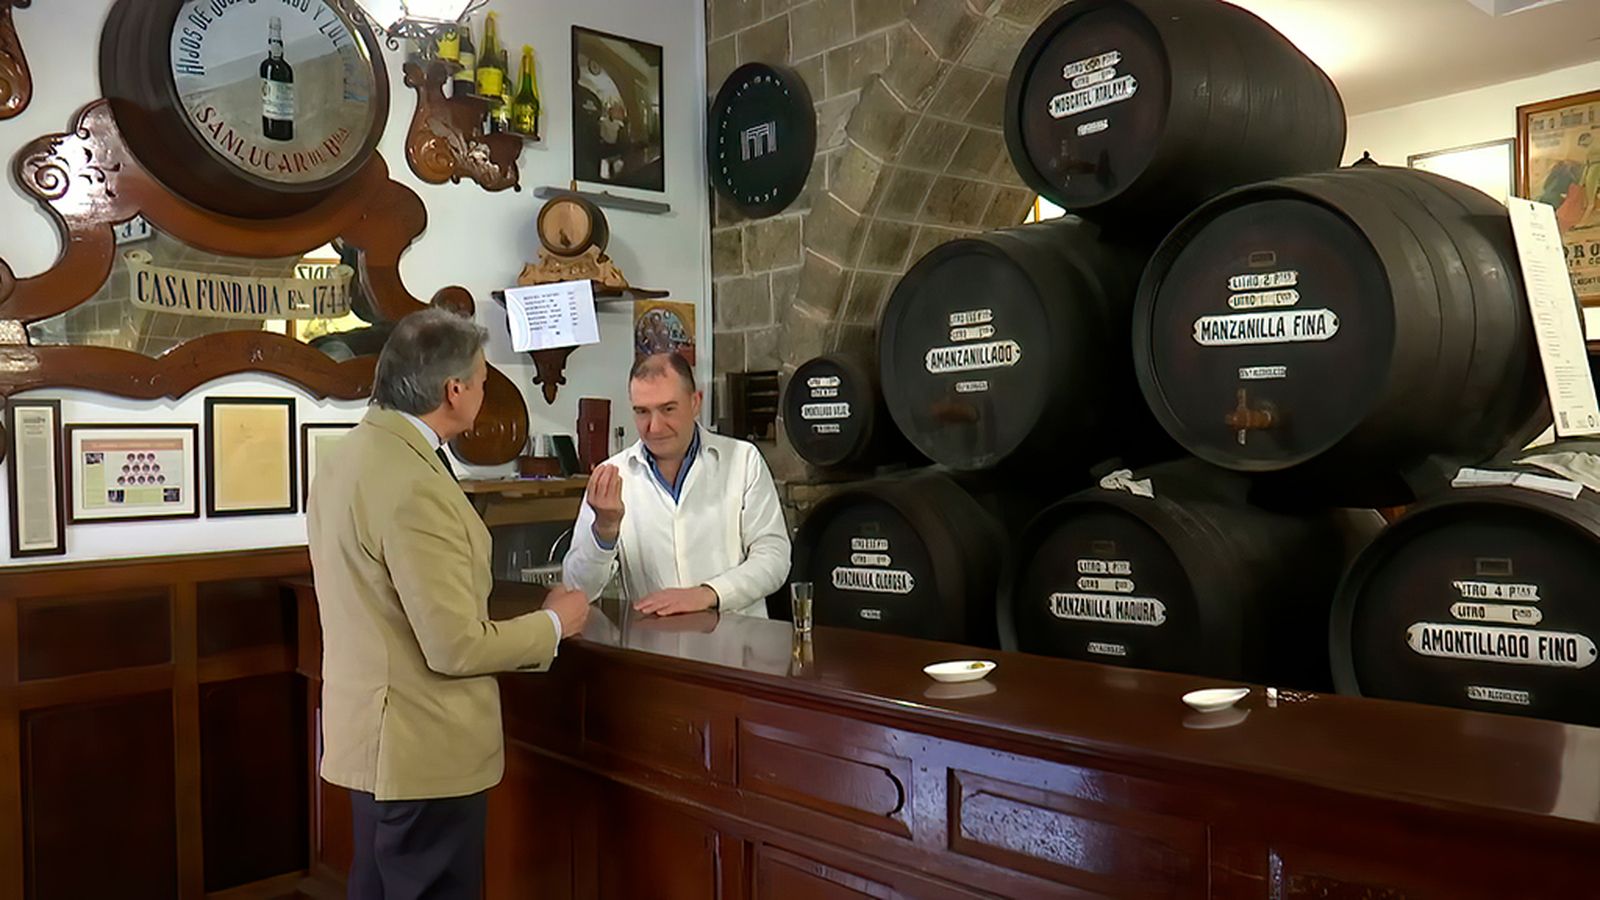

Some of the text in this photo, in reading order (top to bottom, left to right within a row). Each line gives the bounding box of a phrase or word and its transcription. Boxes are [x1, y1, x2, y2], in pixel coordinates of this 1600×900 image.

[188, 6, 213, 31] DE
[177, 27, 206, 76] HIJOS
[1054, 91, 1092, 113] MOSCATEL
[197, 107, 309, 173] SANLUCAR
[136, 271, 190, 309] CASA
[197, 278, 281, 315] FUNDADA
[1200, 314, 1327, 341] MANZANILLA FINA
[930, 344, 1012, 369] AMANZANILLADO
[835, 570, 873, 588] MANZANILLA
[1494, 586, 1503, 597] 4
[1055, 596, 1112, 619] MANZANILLA
[1457, 606, 1486, 619] LITRO
[1421, 628, 1578, 662] AMONTILLADO FINO
